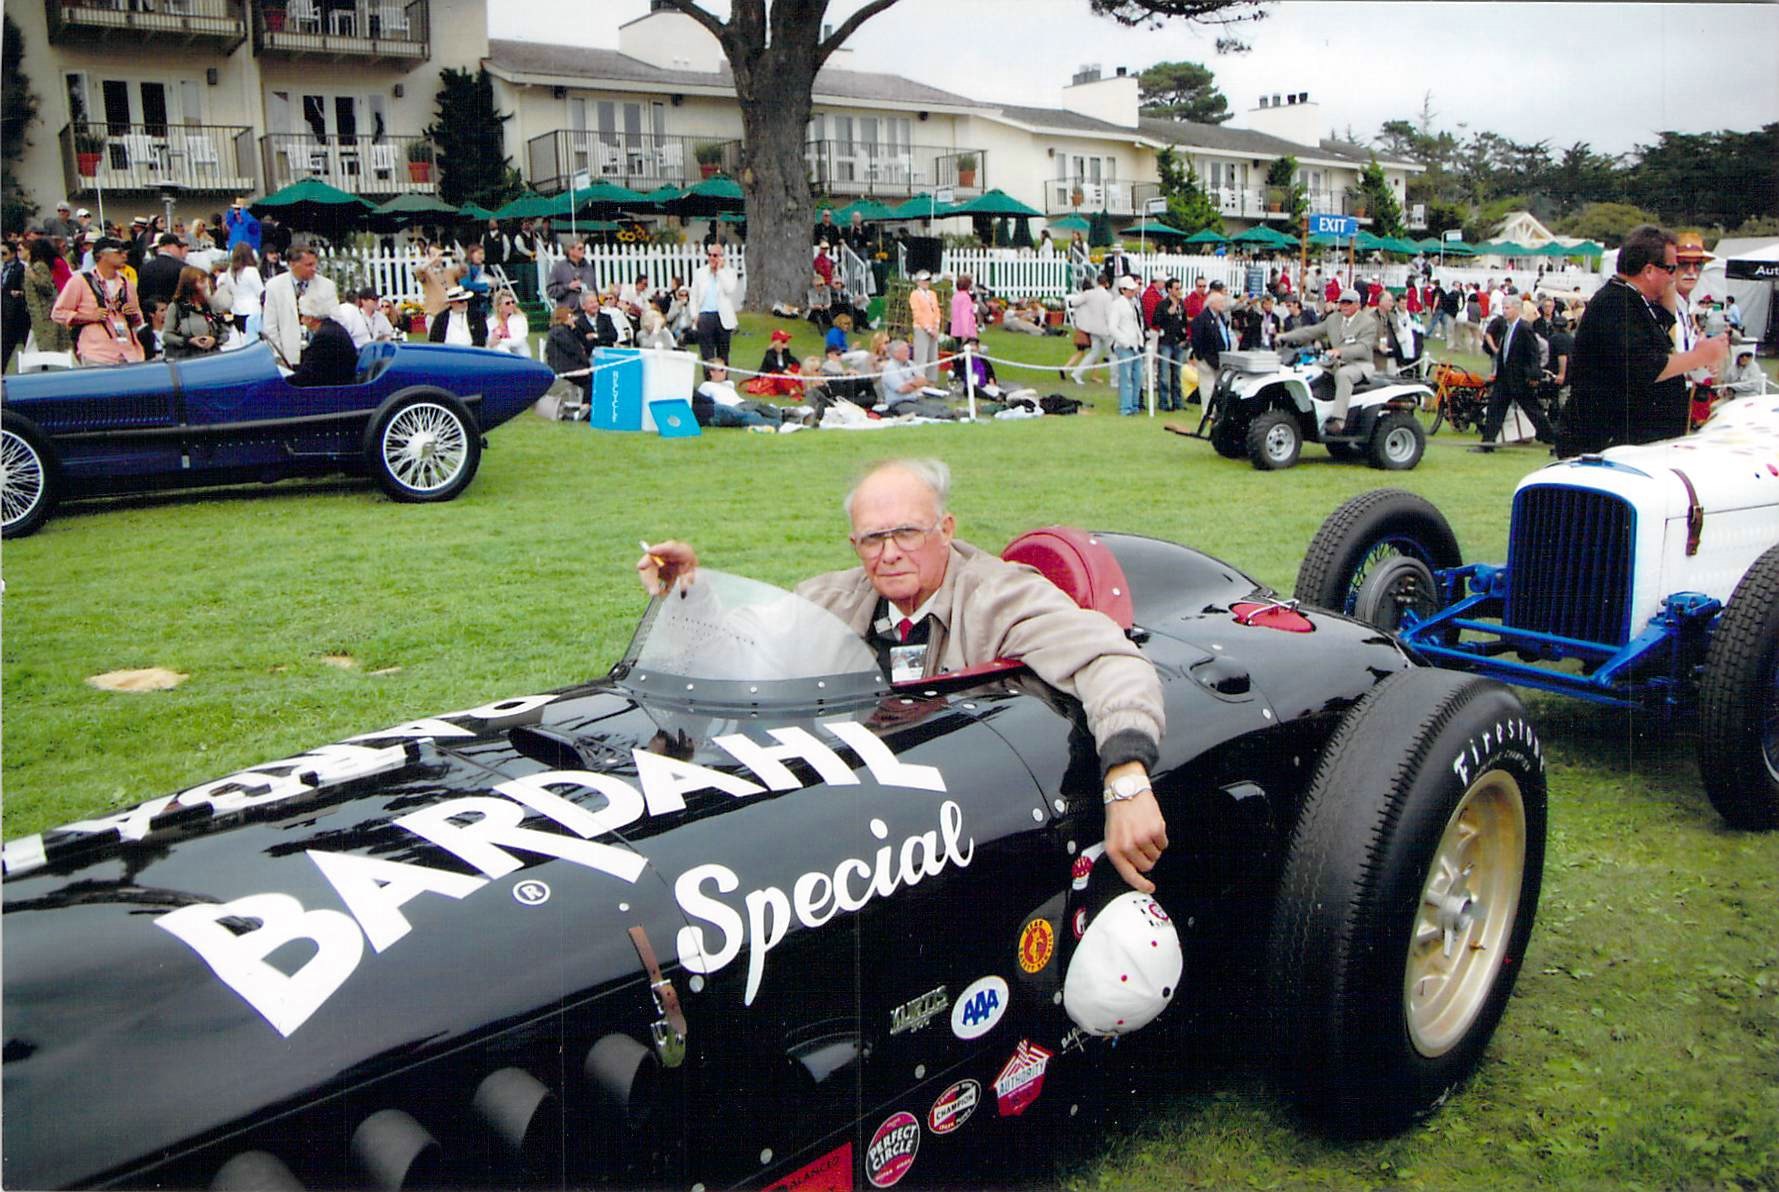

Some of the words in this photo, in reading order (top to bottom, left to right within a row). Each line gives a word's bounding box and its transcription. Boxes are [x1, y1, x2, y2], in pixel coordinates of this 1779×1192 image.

[1319, 217, 1347, 233] EXIT
[155, 721, 946, 1038] BARDAHL
[675, 800, 975, 1007] Special
[962, 988, 999, 1026] AAA
[999, 1062, 1044, 1095] AUTHORITY
[936, 1094, 974, 1120] CHAMPION
[869, 1124, 917, 1161] PERFECT
[872, 1139, 913, 1172] CIRCLE
